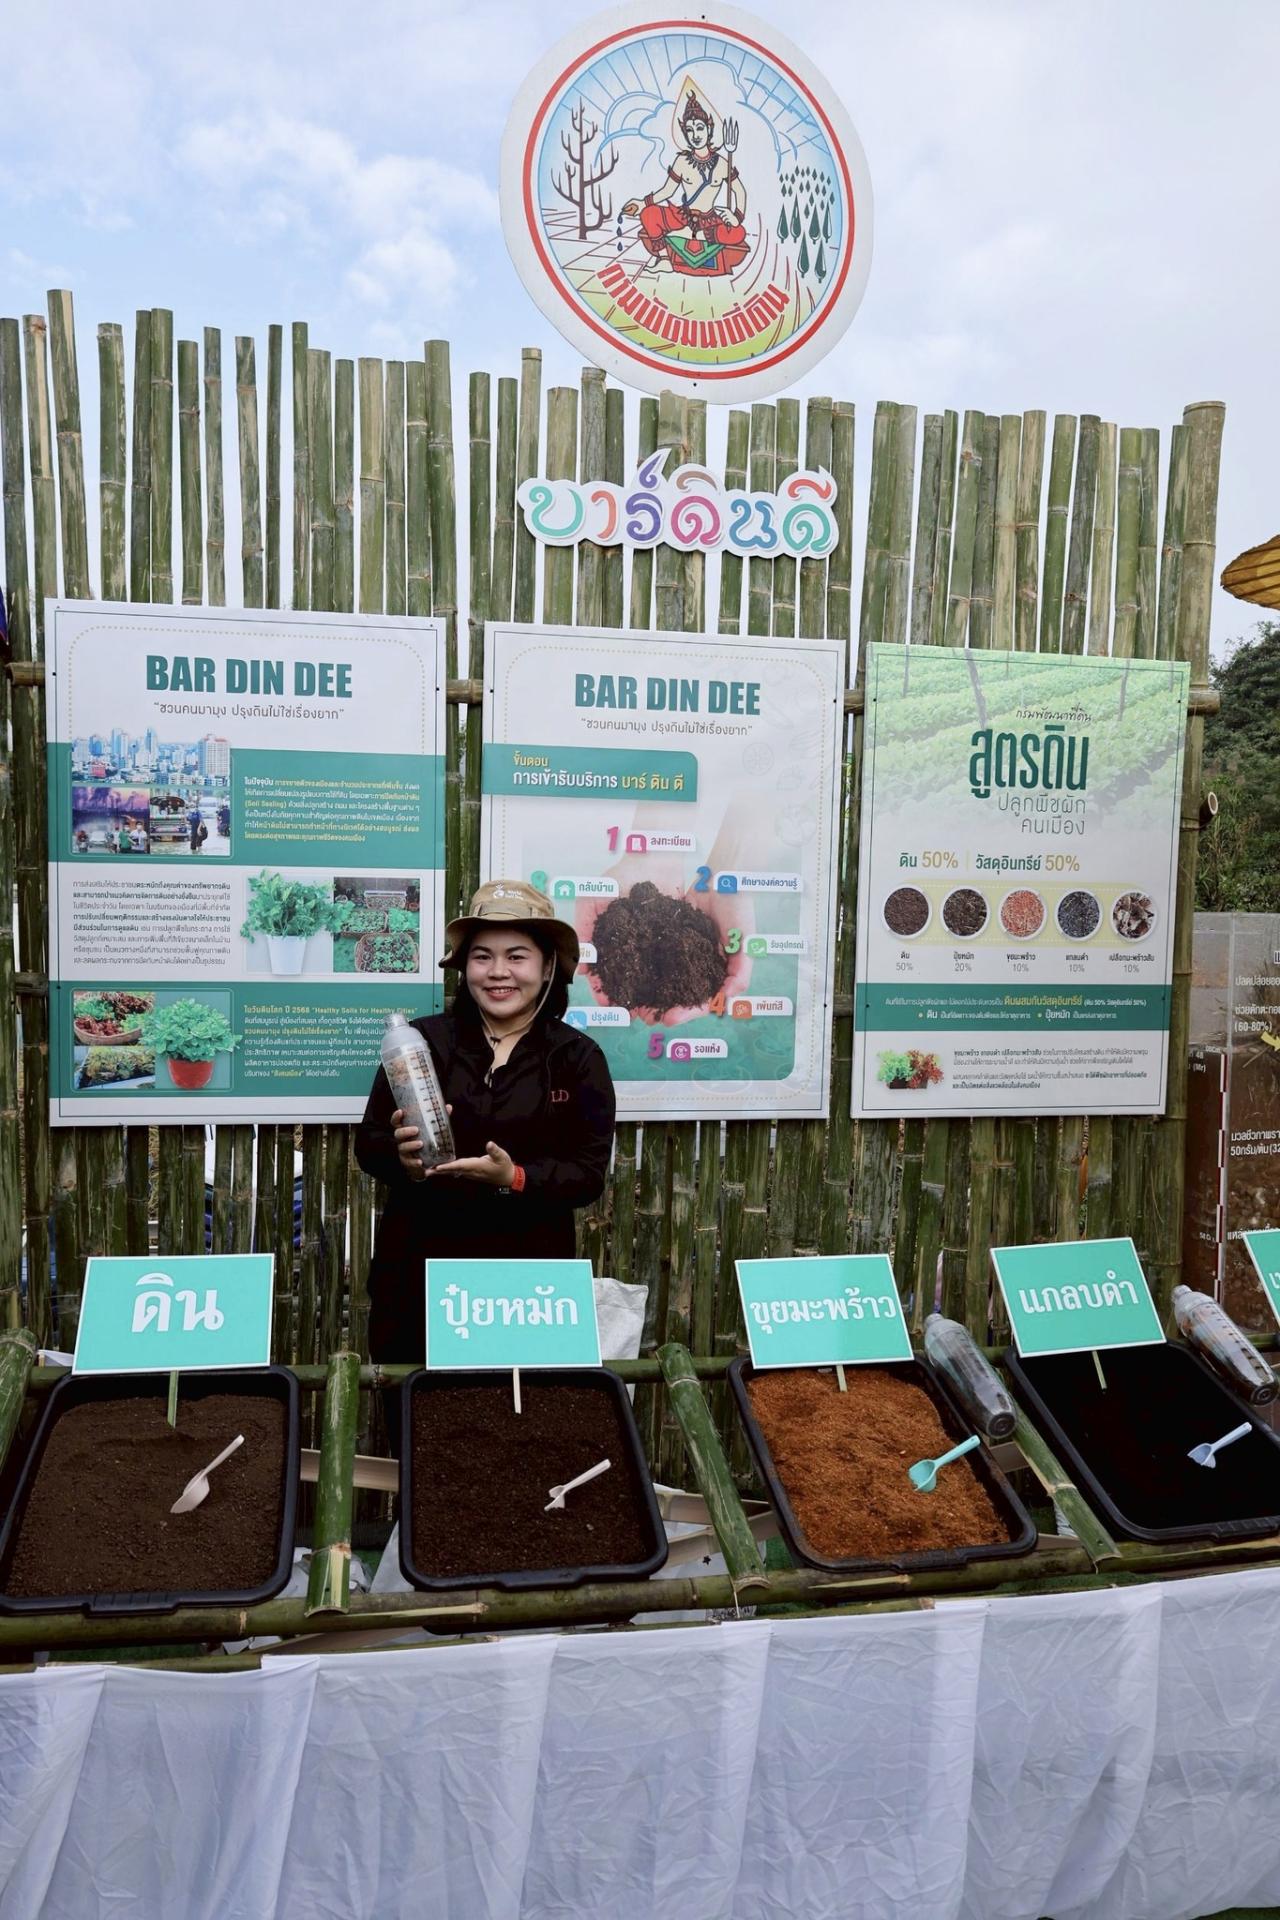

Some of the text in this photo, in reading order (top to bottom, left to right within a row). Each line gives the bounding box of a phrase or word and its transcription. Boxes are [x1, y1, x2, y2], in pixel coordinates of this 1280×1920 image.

[529, 453, 832, 552] บาร์ดินดี
[146, 655, 352, 698] BAR DIN DEE
[575, 673, 760, 715] BAR DIN DEE
[513, 751, 549, 767] ขั้นตอน
[969, 725, 1089, 798] สูตรดิน
[513, 768, 684, 790] การเข้ารับบริการ บาร์ ดิน ดี
[1021, 815, 1085, 835] คนเมือง
[606, 826, 620, 851] 1
[650, 835, 691, 848] ลงทะเบียน
[899, 851, 1080, 874] ดิน 50% วัสดุอินทรีย์ 50%
[579, 881, 614, 893] กลับบ้าน
[694, 866, 712, 892] 2
[725, 928, 742, 954] 3
[896, 962, 913, 972] 50%
[955, 963, 972, 972] 20%
[1012, 963, 1029, 973] 10%
[1069, 964, 1085, 973] 10%
[1123, 964, 1139, 973] 10%
[709, 991, 726, 1016] 4
[927, 1008, 938, 1019] ดิน
[592, 1012, 619, 1025] ปรุงดิน
[1234, 1021, 1272, 1032] (60-80%)
[648, 1033, 665, 1059] 5
[132, 1273, 225, 1332] ดิน
[1018, 1270, 1139, 1313] แกลบดำ
[439, 1283, 579, 1339] ปุ๋ยหมัก
[750, 1287, 897, 1334] ขุยมะพร้าว
